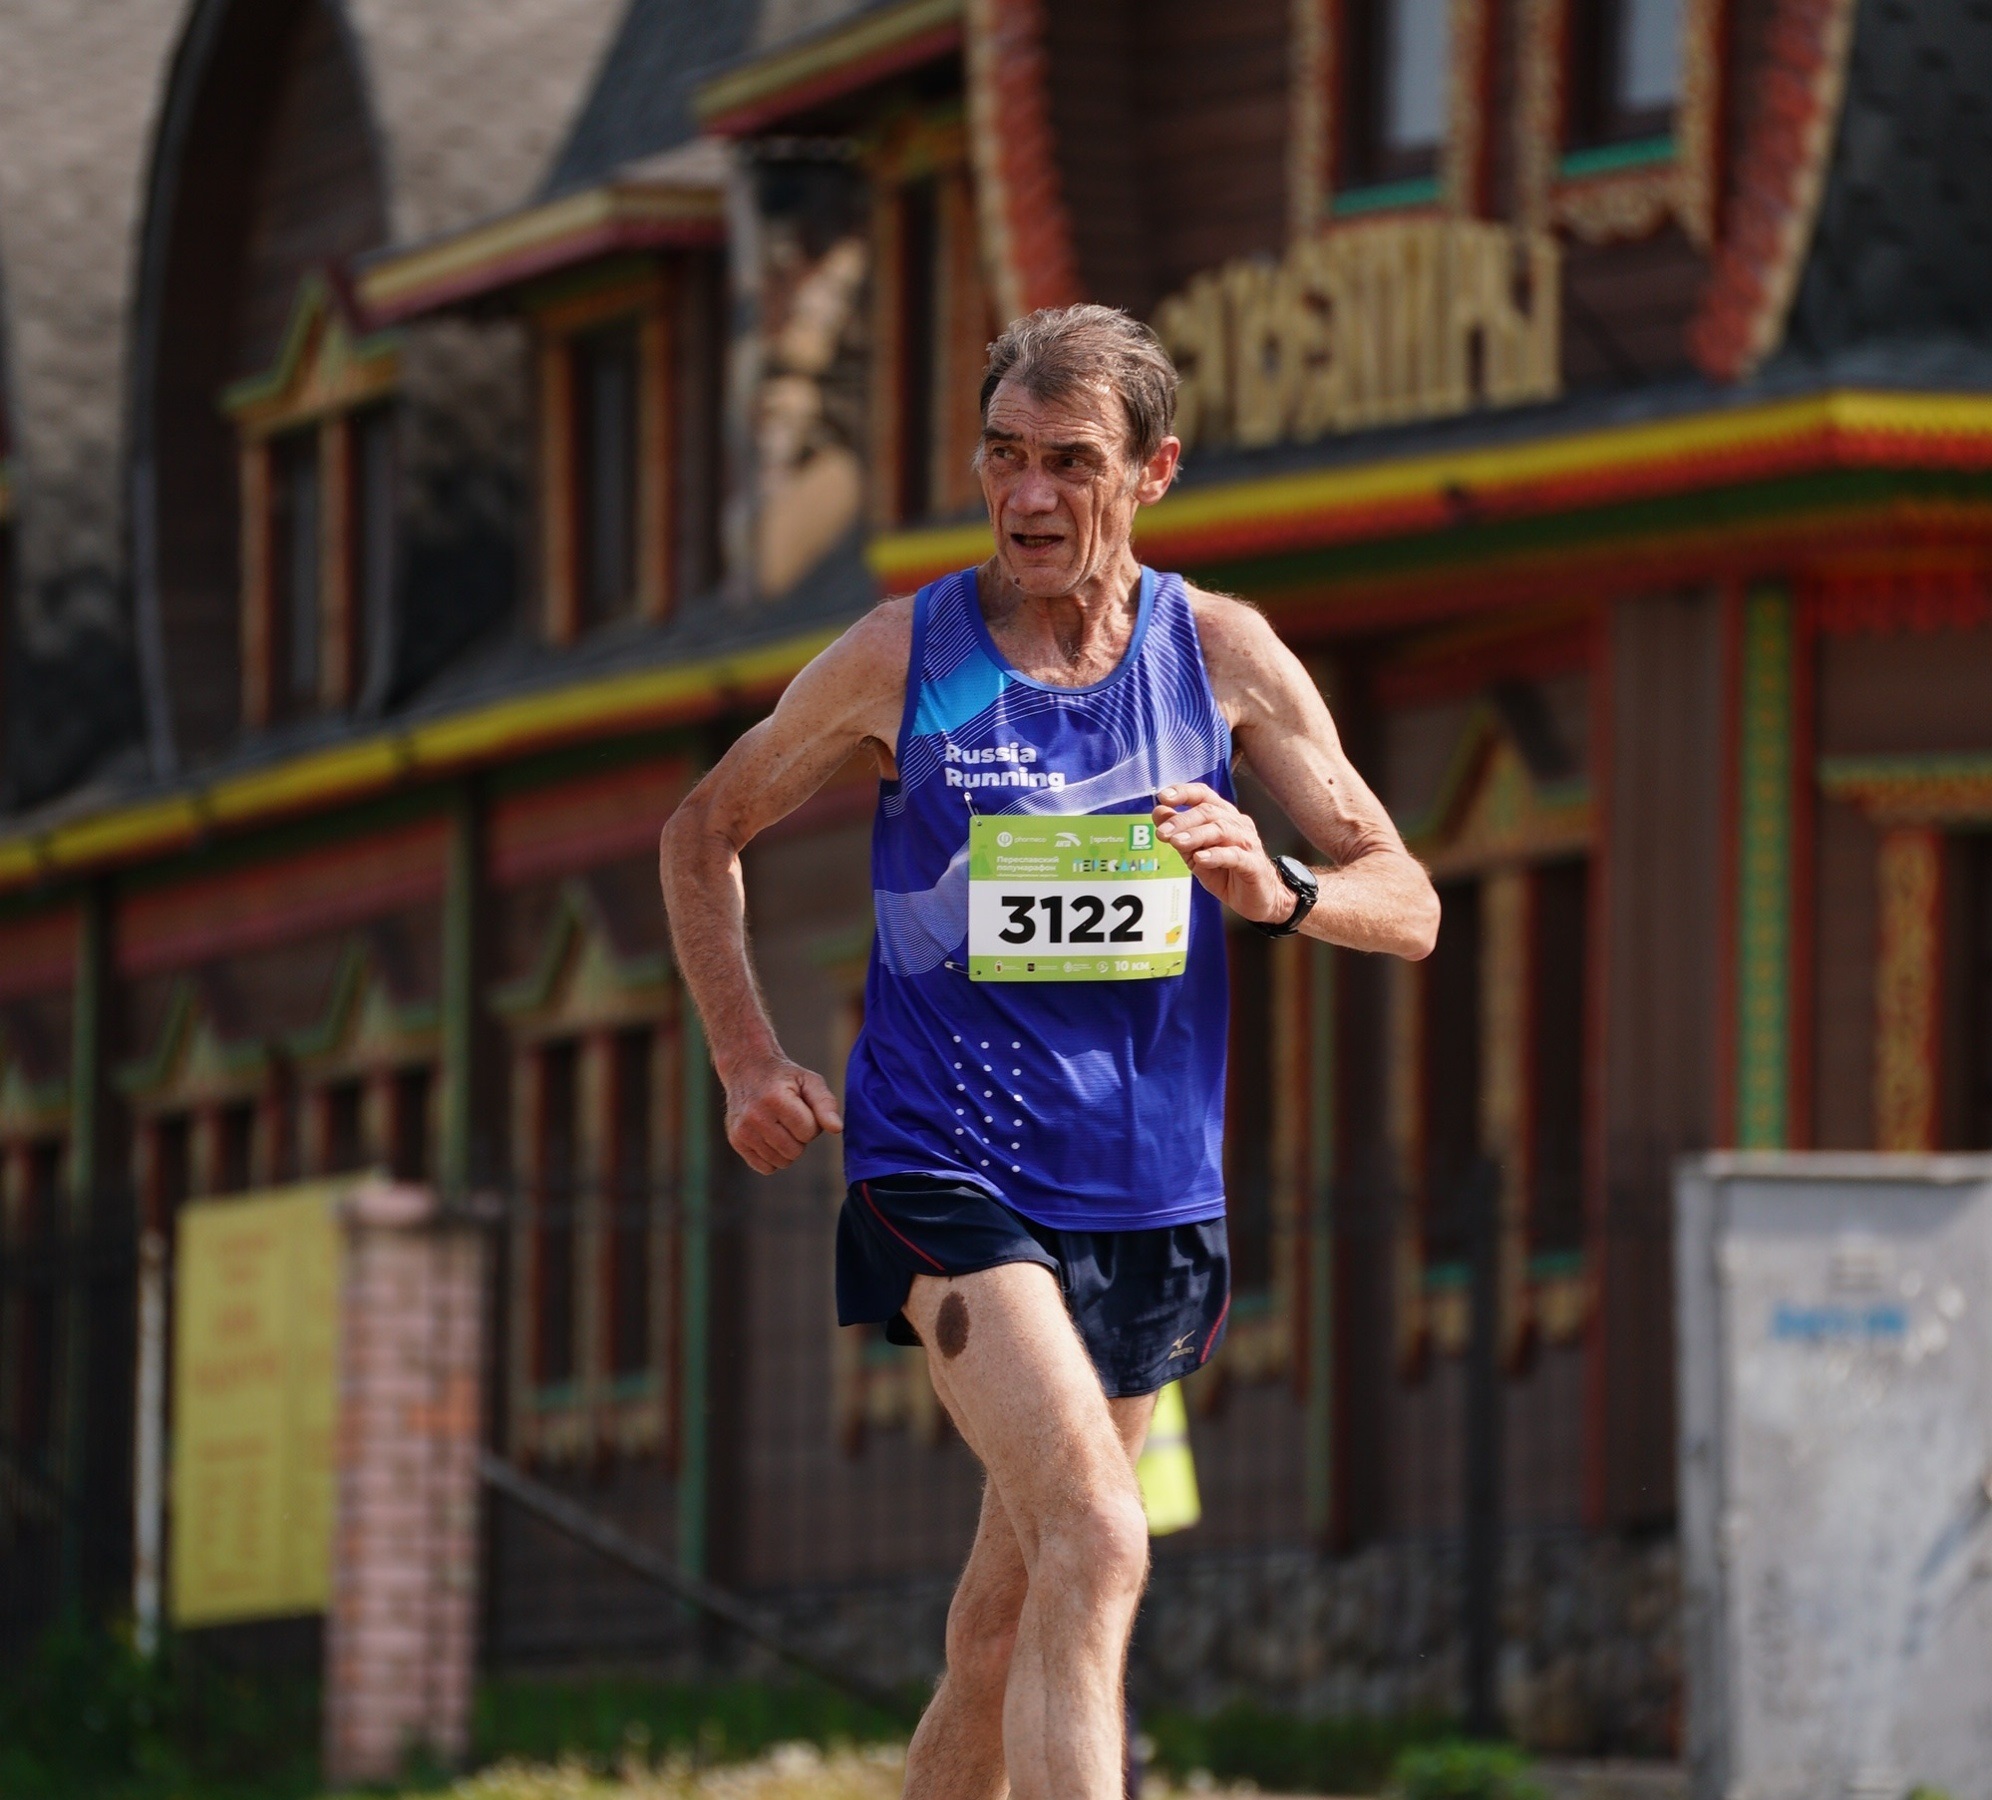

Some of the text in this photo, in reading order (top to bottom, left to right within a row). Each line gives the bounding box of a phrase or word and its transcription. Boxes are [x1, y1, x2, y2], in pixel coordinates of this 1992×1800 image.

[945, 742, 1037, 764] Russia
[945, 767, 1066, 792] Running
[996, 864, 1057, 872] полумарафон
[998, 894, 1144, 945] 3122
[1114, 960, 1129, 972] 10
